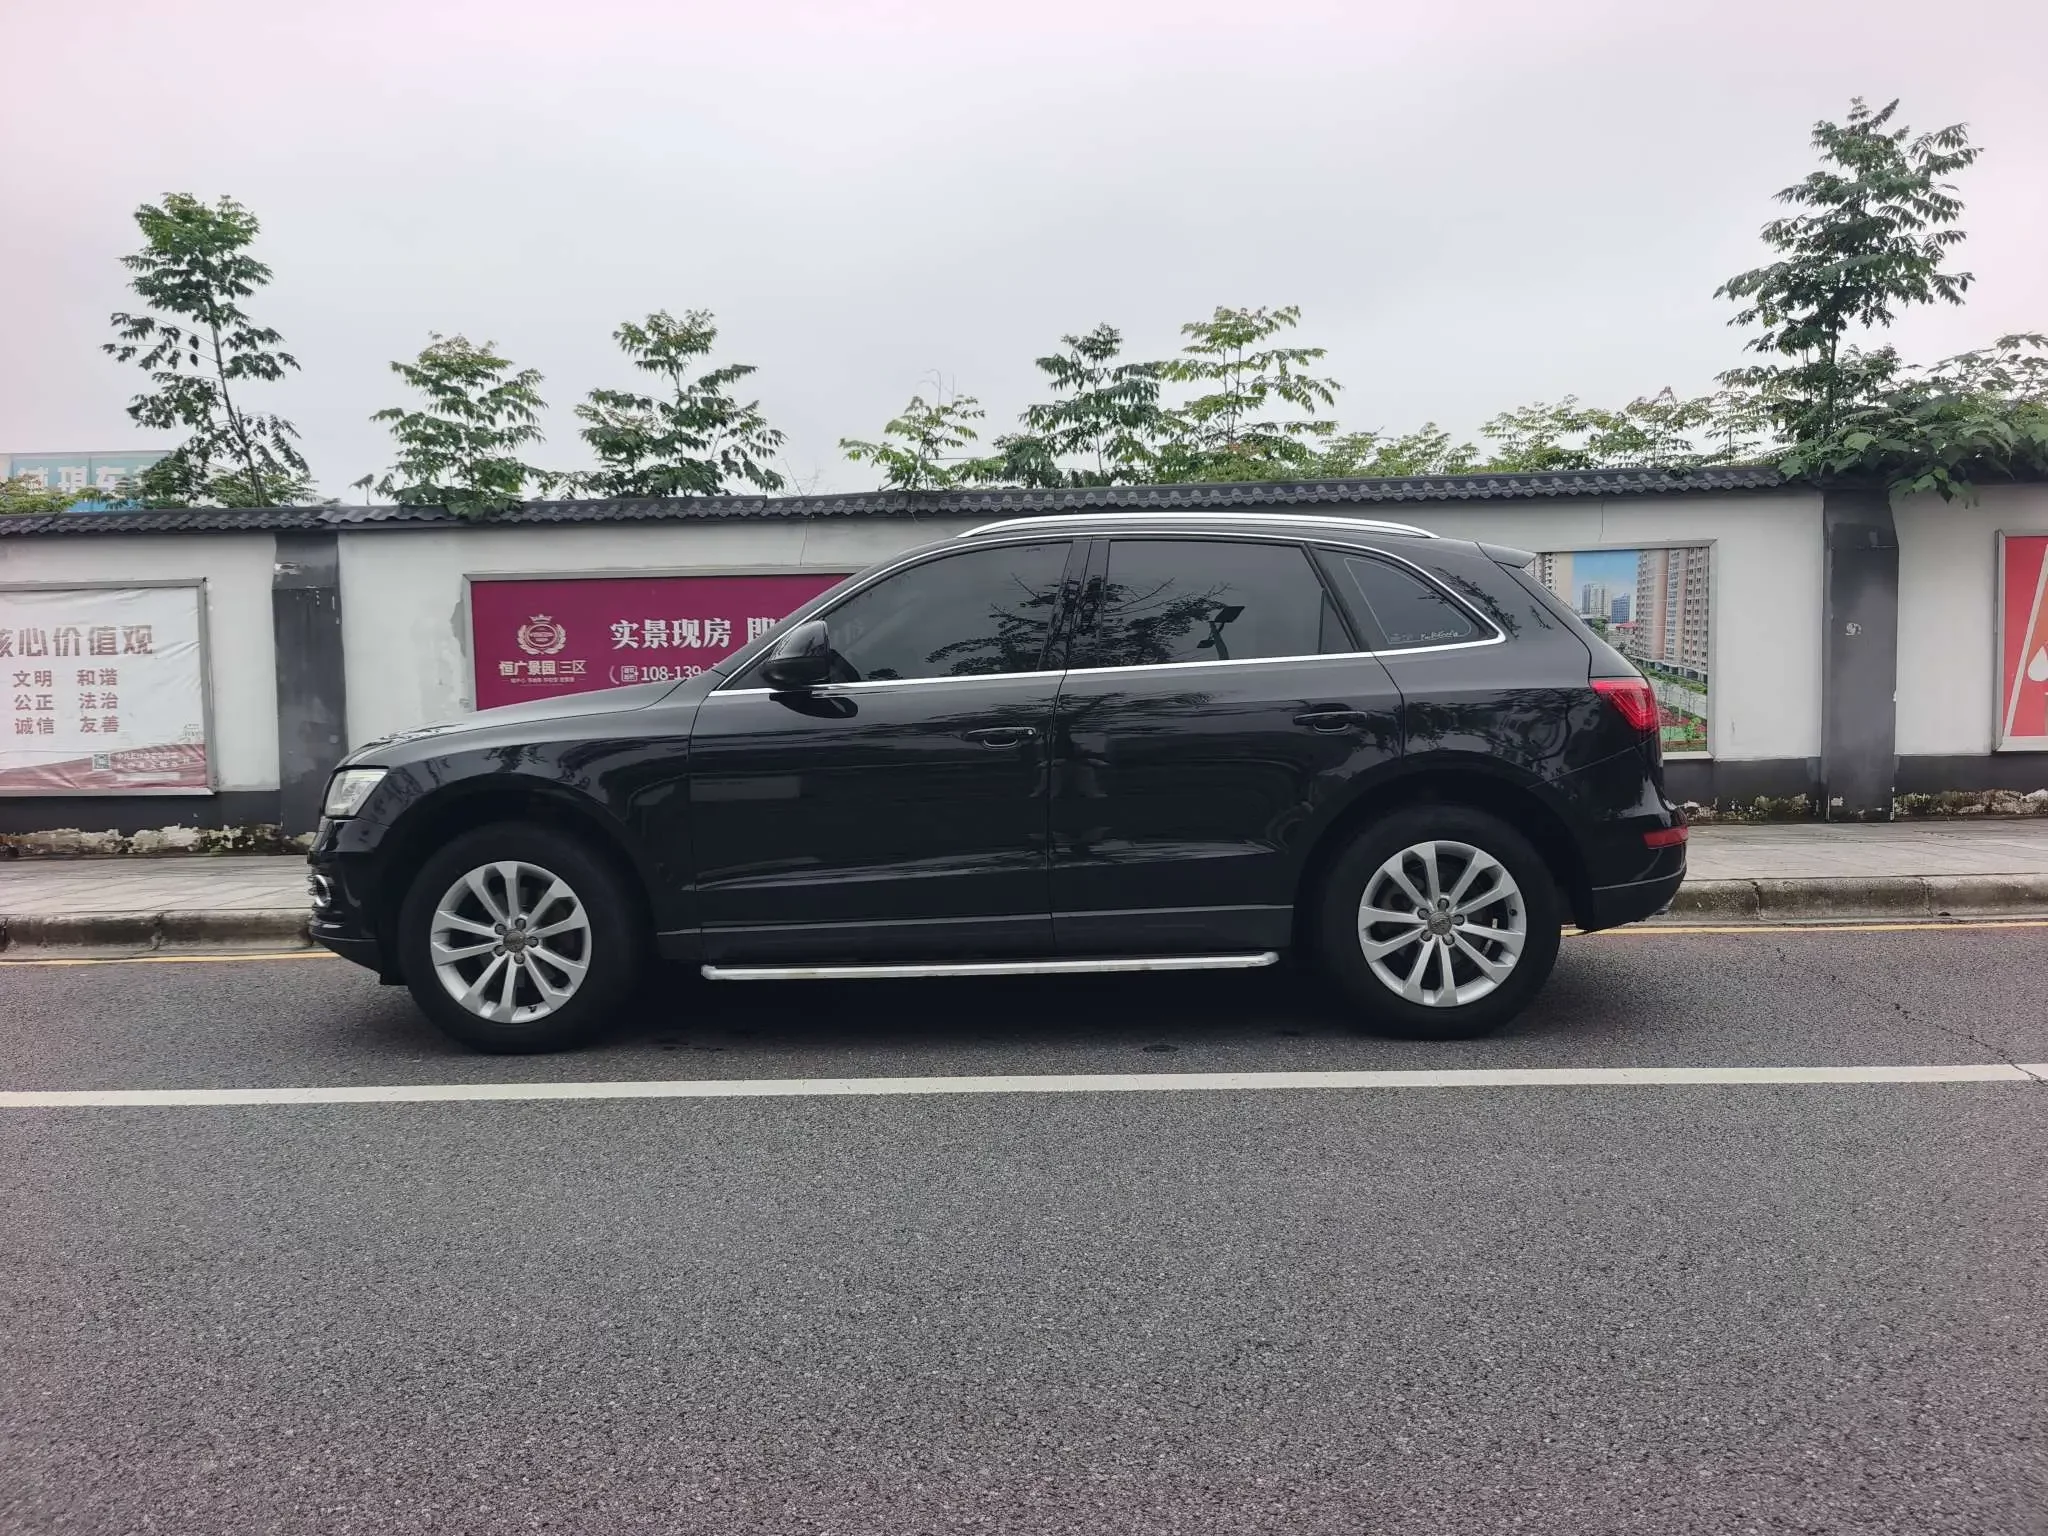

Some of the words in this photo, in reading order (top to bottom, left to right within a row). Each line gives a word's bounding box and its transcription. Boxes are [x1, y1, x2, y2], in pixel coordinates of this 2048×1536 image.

[610, 618, 732, 650] 实景现房
[560, 660, 587, 674] 三区
[13, 670, 52, 688] 文明
[76, 668, 118, 686] 和谐
[14, 694, 54, 711] 公正
[79, 692, 119, 709] 法治
[15, 717, 54, 735] 诚信
[80, 715, 119, 733] 友善
